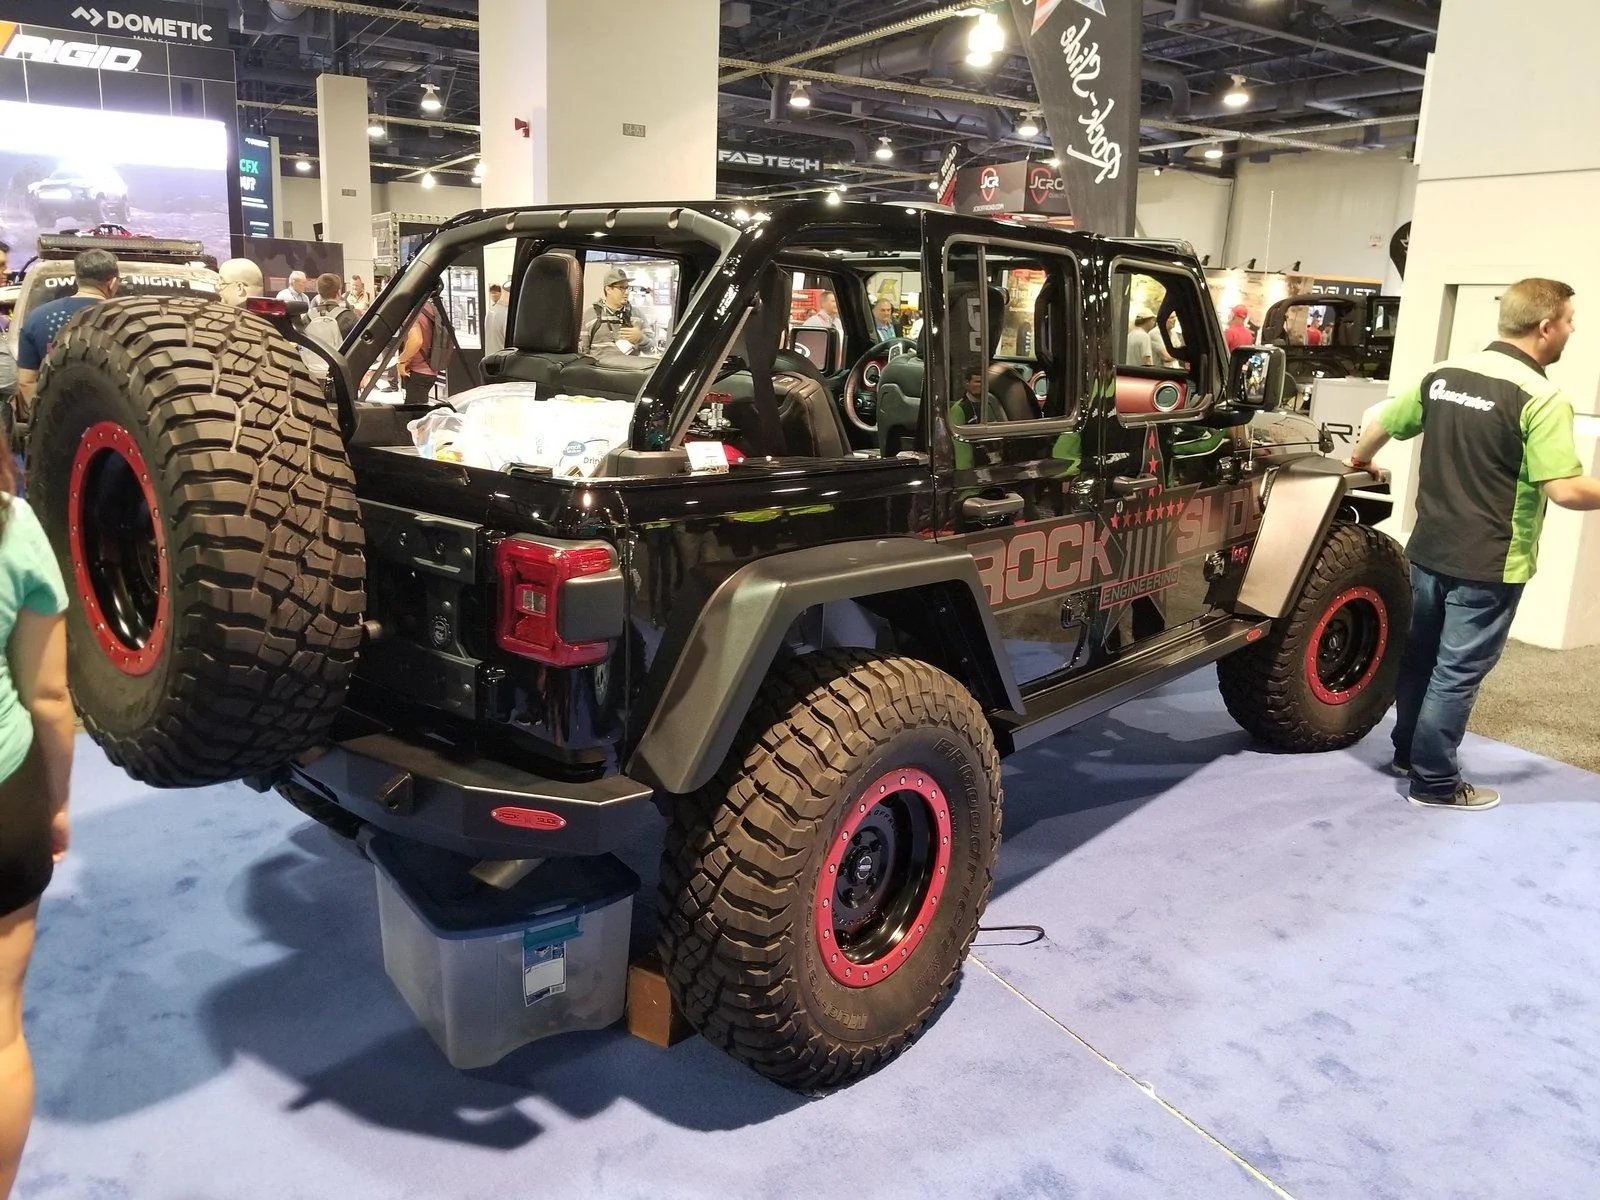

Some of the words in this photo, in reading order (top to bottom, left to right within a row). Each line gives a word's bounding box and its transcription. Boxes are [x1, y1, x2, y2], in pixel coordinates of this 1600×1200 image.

[107, 10, 213, 42] DOMETIC
[3, 33, 143, 72] RIGID
[240, 158, 259, 175] CFX
[718, 150, 819, 173] FABTECH
[980, 175, 1000, 189] JCR
[44, 276, 77, 288] OW
[132, 275, 186, 288] NIGHT.
[966, 520, 1114, 606] ROCK
[1102, 569, 1179, 605] ENGINEERING
